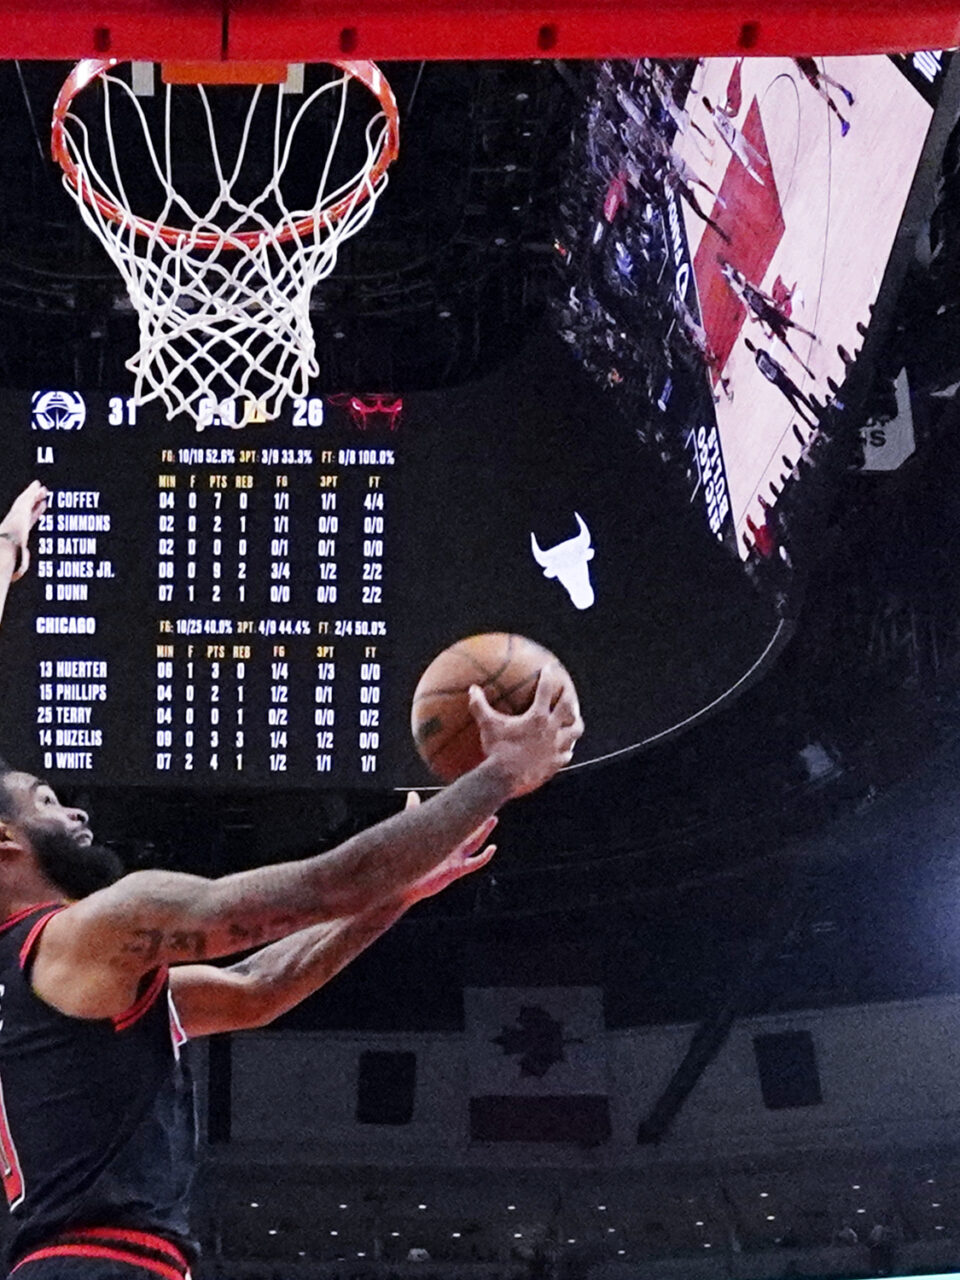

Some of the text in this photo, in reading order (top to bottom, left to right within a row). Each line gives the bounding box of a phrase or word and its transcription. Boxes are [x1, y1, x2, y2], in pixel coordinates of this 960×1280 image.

[108, 398, 323, 426] 31 26
[37, 447, 53, 463] LA
[159, 475, 380, 488] MIN PTS FG 3PT FT
[58, 491, 99, 508] COFFEY
[159, 492, 174, 508] 04
[214, 492, 221, 509] 7
[274, 492, 289, 509] 1/1
[321, 493, 336, 510] 1/1
[364, 493, 383, 510] 4/4
[38, 514, 383, 533] 25 SIMMONS 02 2 1/1 0/0 0/0
[39, 538, 383, 557] 33 BATUM 02 0 0/1 0/1 0/0
[38, 561, 382, 580] 55 JONES JR. 08 9 3/4 1/2 2/2
[46, 584, 381, 603] 8 DUNN 07 2 0/0 0/0 2/2
[36, 617, 95, 634] CHICAGO
[157, 645, 376, 658] MIN PTS FG 3PT FT
[40, 661, 380, 680] 13 HUERTER 06 3 1/4 1/3 0/0
[40, 684, 380, 703] 15 PHILLIPS 04 2 1/2 0/1 0/0
[37, 707, 379, 726] 25 TERRY 04 0 0/2 0/0 0/2
[39, 730, 379, 749] 14 BUZELIS 09 3 1/4 1/2 0/0
[45, 752, 376, 772] 0 WHITE 07 4 1/2 1/1 1/1
